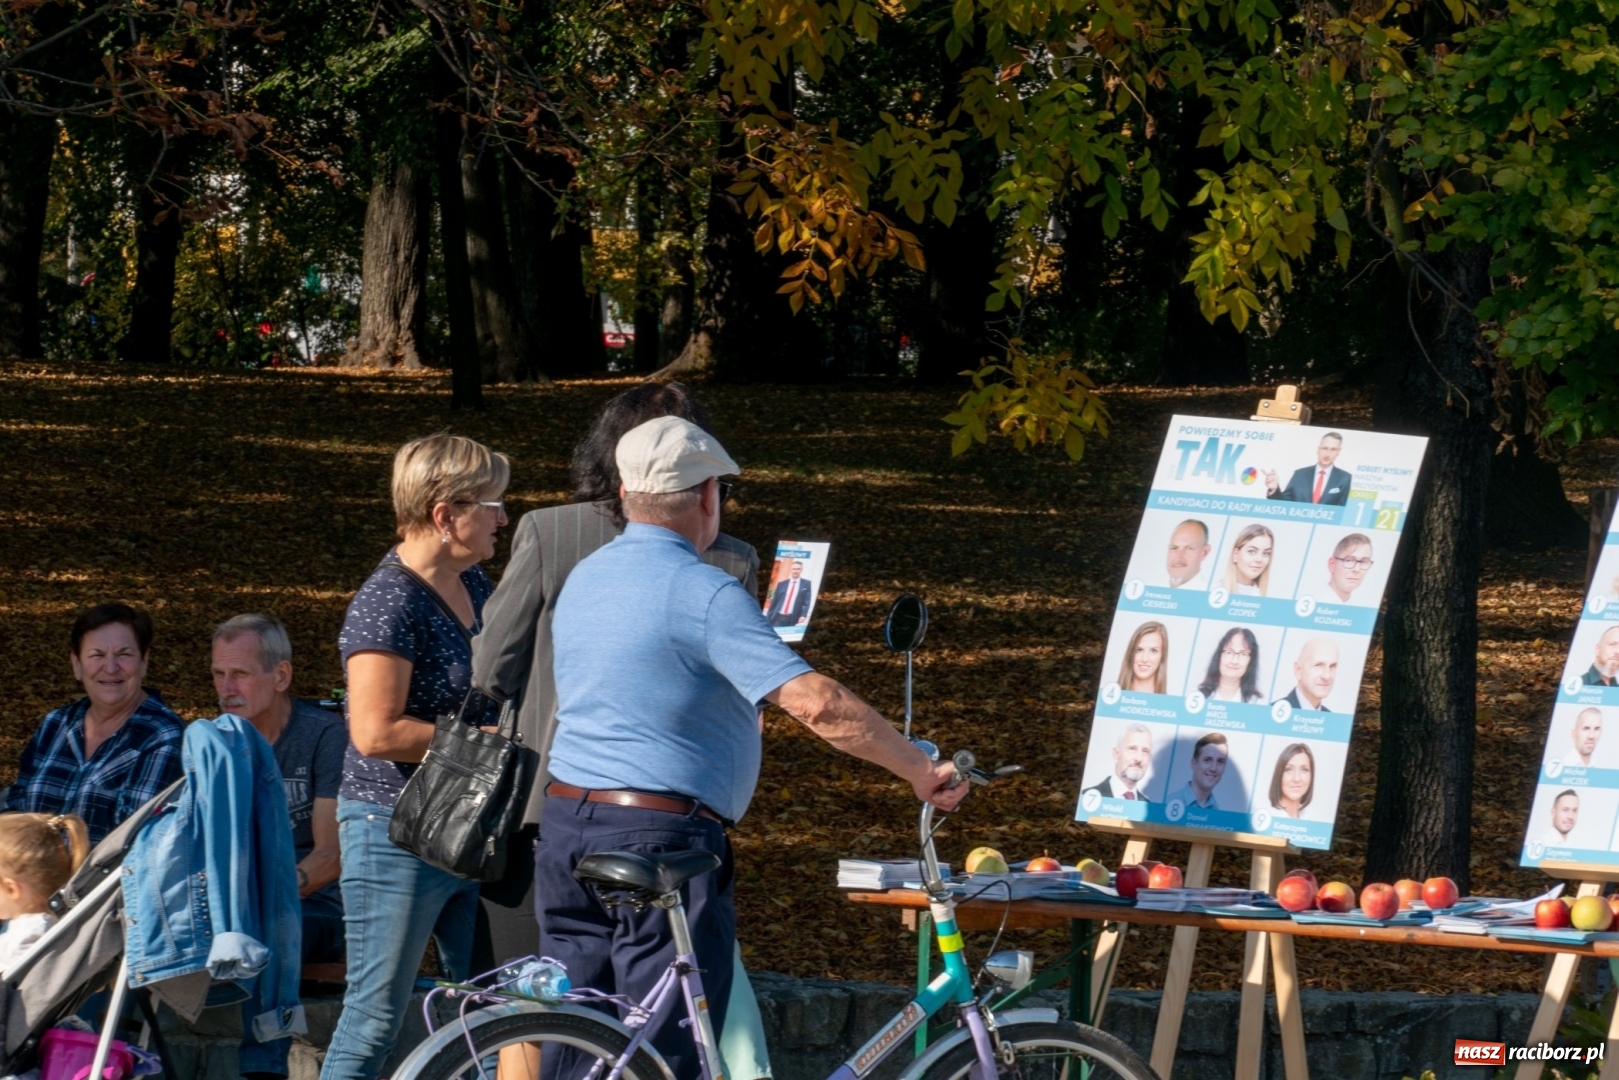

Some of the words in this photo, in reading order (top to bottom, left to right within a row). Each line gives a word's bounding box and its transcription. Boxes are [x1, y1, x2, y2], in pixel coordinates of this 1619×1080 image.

[1178, 425, 1242, 438] POWIEDZMY
[1244, 430, 1275, 441] SOBIE
[1356, 464, 1381, 473] ROBERT
[1157, 495, 1210, 509] KANDYDACI
[1210, 501, 1226, 510] DO
[1228, 502, 1252, 513] RADY
[1253, 505, 1287, 516] MIASTA
[1288, 506, 1336, 520] RACIBÓRZ
[1355, 502, 1366, 526] 1
[1376, 509, 1400, 530] 21
[1130, 582, 1138, 596] 1
[1144, 590, 1172, 600] Ireneusz
[1213, 591, 1224, 604] 2
[1142, 600, 1178, 610] CIESIELSKI
[1300, 600, 1310, 613] 3
[1316, 606, 1339, 616] Robert
[1228, 608, 1257, 618] CZOPEK
[1313, 616, 1354, 626] KOZIARSKI
[1567, 678, 1578, 692] 4
[1106, 686, 1115, 699] 4
[1120, 696, 1148, 706] Barbara
[1190, 695, 1200, 709] 5
[1578, 695, 1602, 704] JANUS
[1276, 704, 1286, 718] 6
[1549, 762, 1561, 776] 7
[1086, 793, 1098, 807] 7
[1170, 803, 1178, 818] 8
[1186, 812, 1208, 822] Daniel
[1258, 813, 1266, 826] 9
[1273, 822, 1308, 833] Katarzyna
[1528, 842, 1543, 856] 10
[1546, 847, 1572, 858] Szymon
